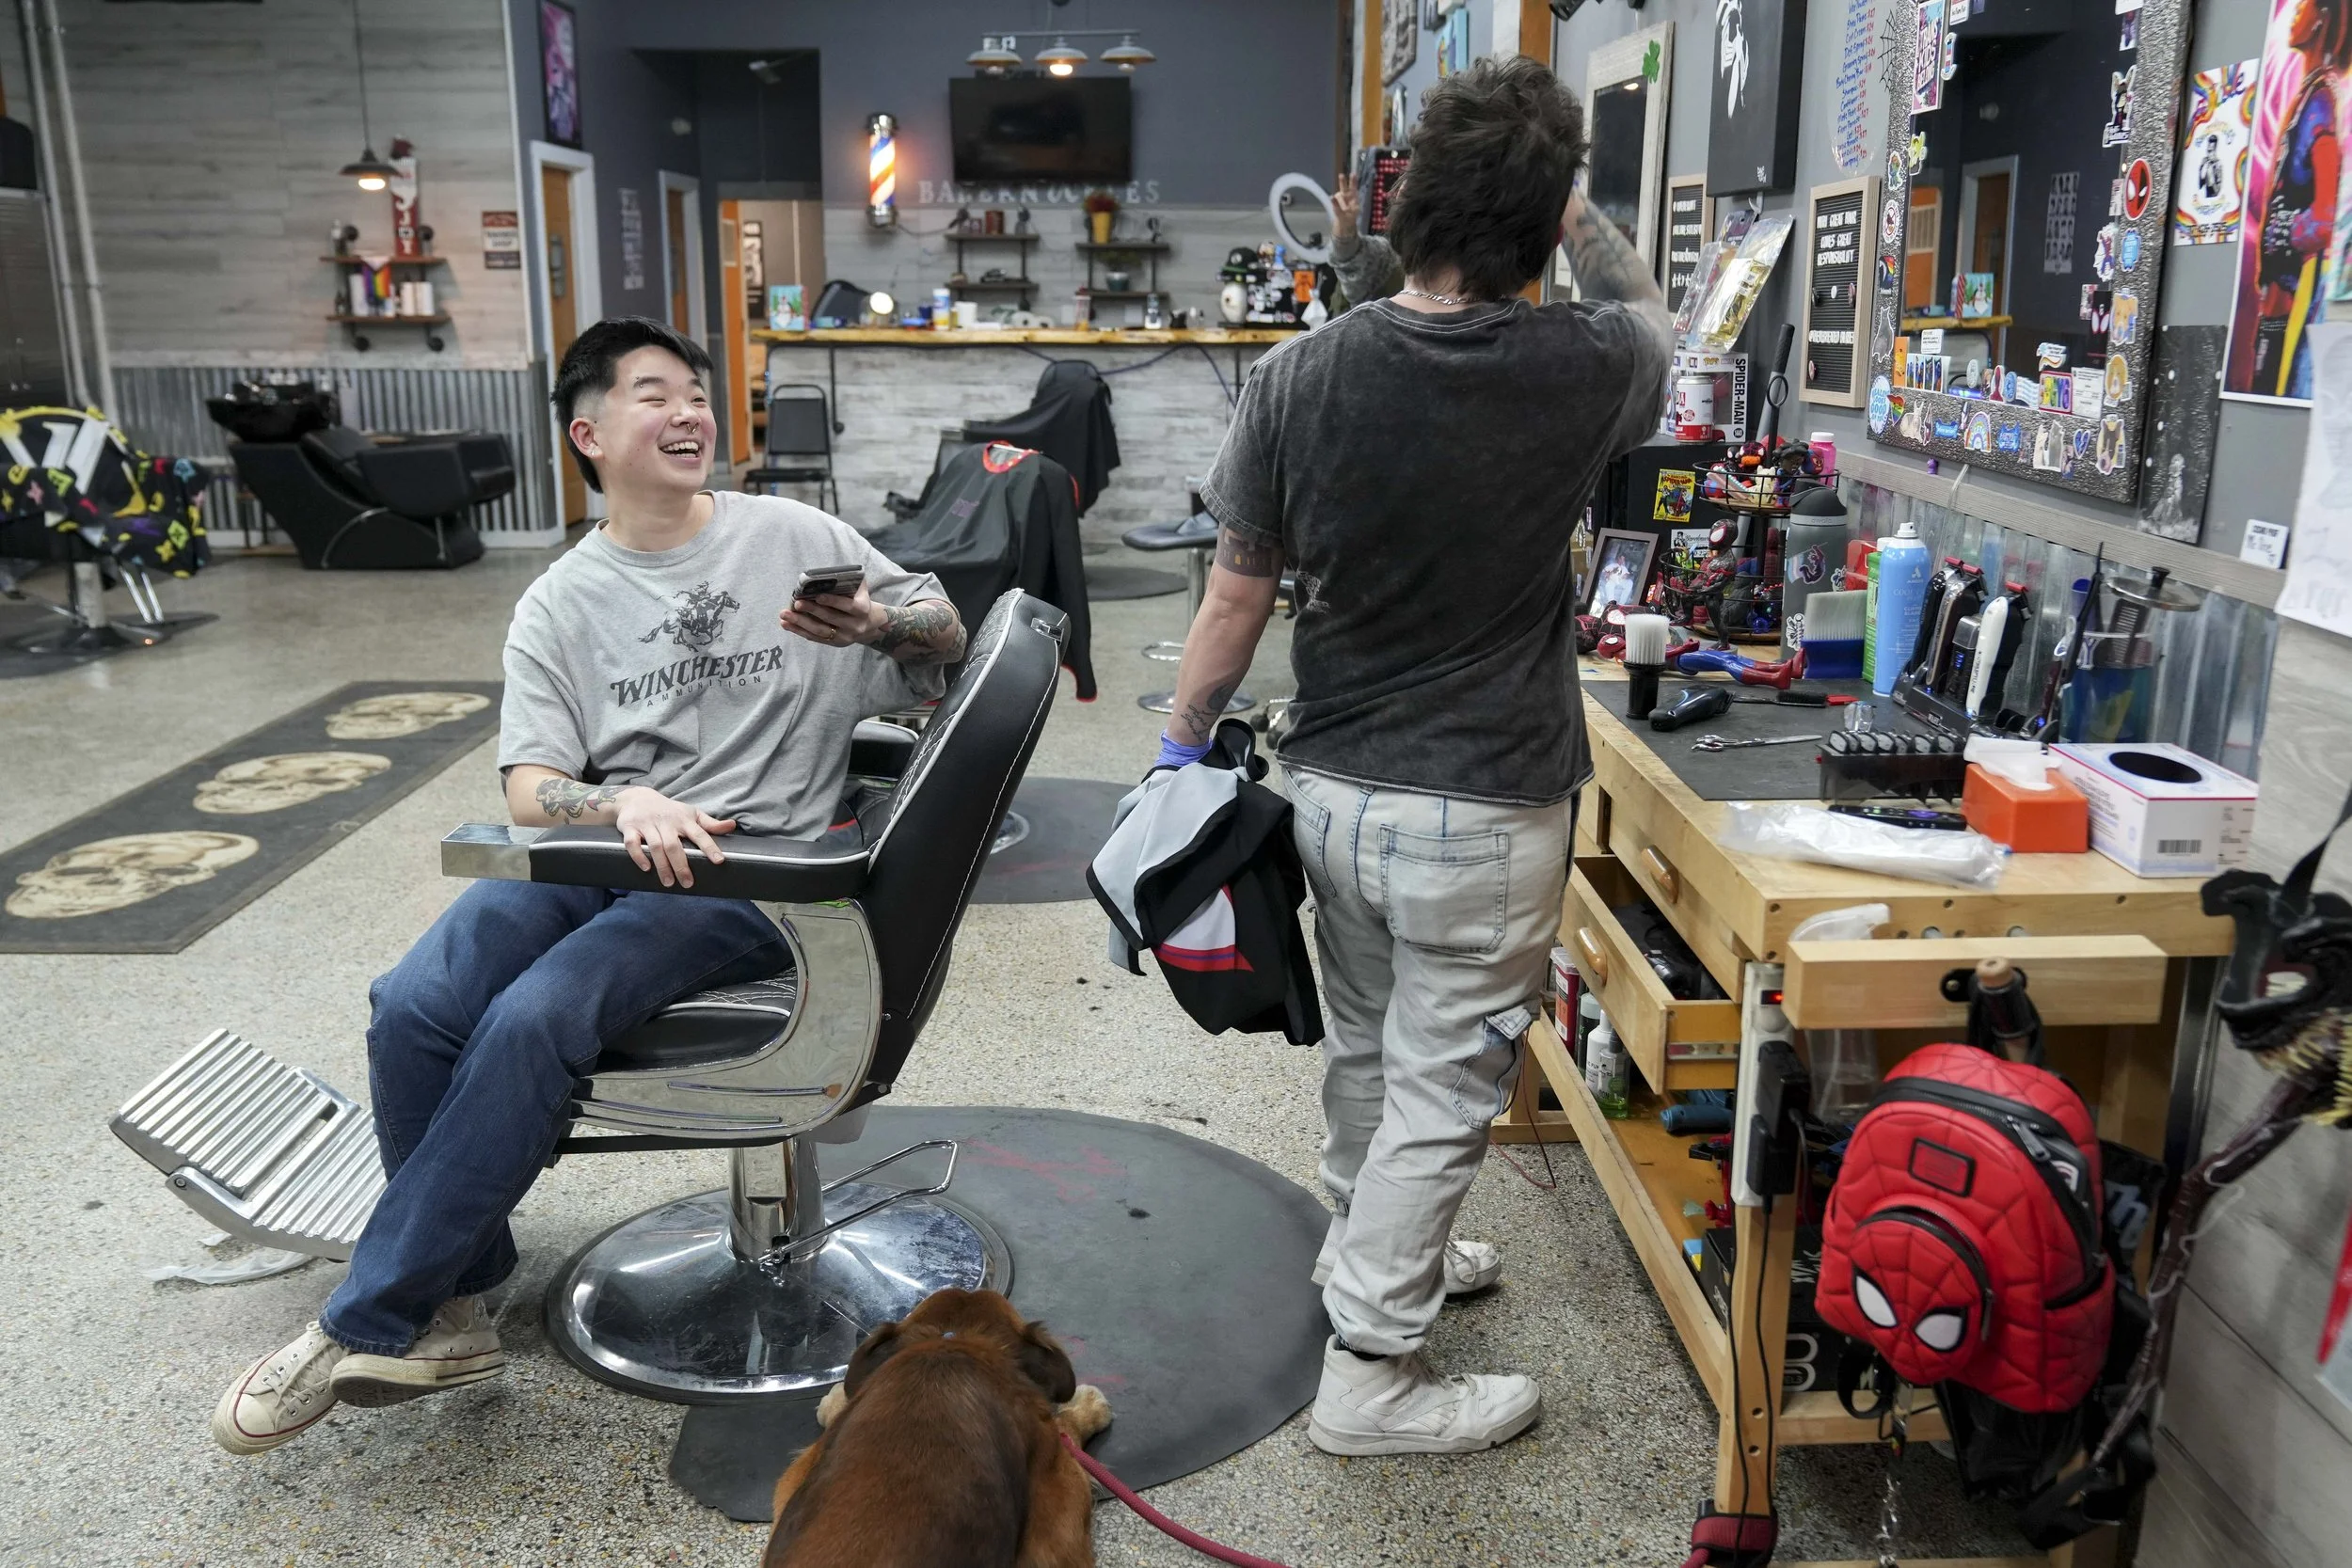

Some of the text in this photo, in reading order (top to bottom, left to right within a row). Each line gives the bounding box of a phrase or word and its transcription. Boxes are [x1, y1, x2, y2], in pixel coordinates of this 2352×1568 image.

[1734, 358, 1746, 425] SPIDER-MAN
[1871, 403, 1886, 415] GOOD
[1662, 476, 1692, 485] SPIDER-MAN
[610, 644, 783, 708] WINCHESTER
[646, 674, 762, 707] AMMUNITION
